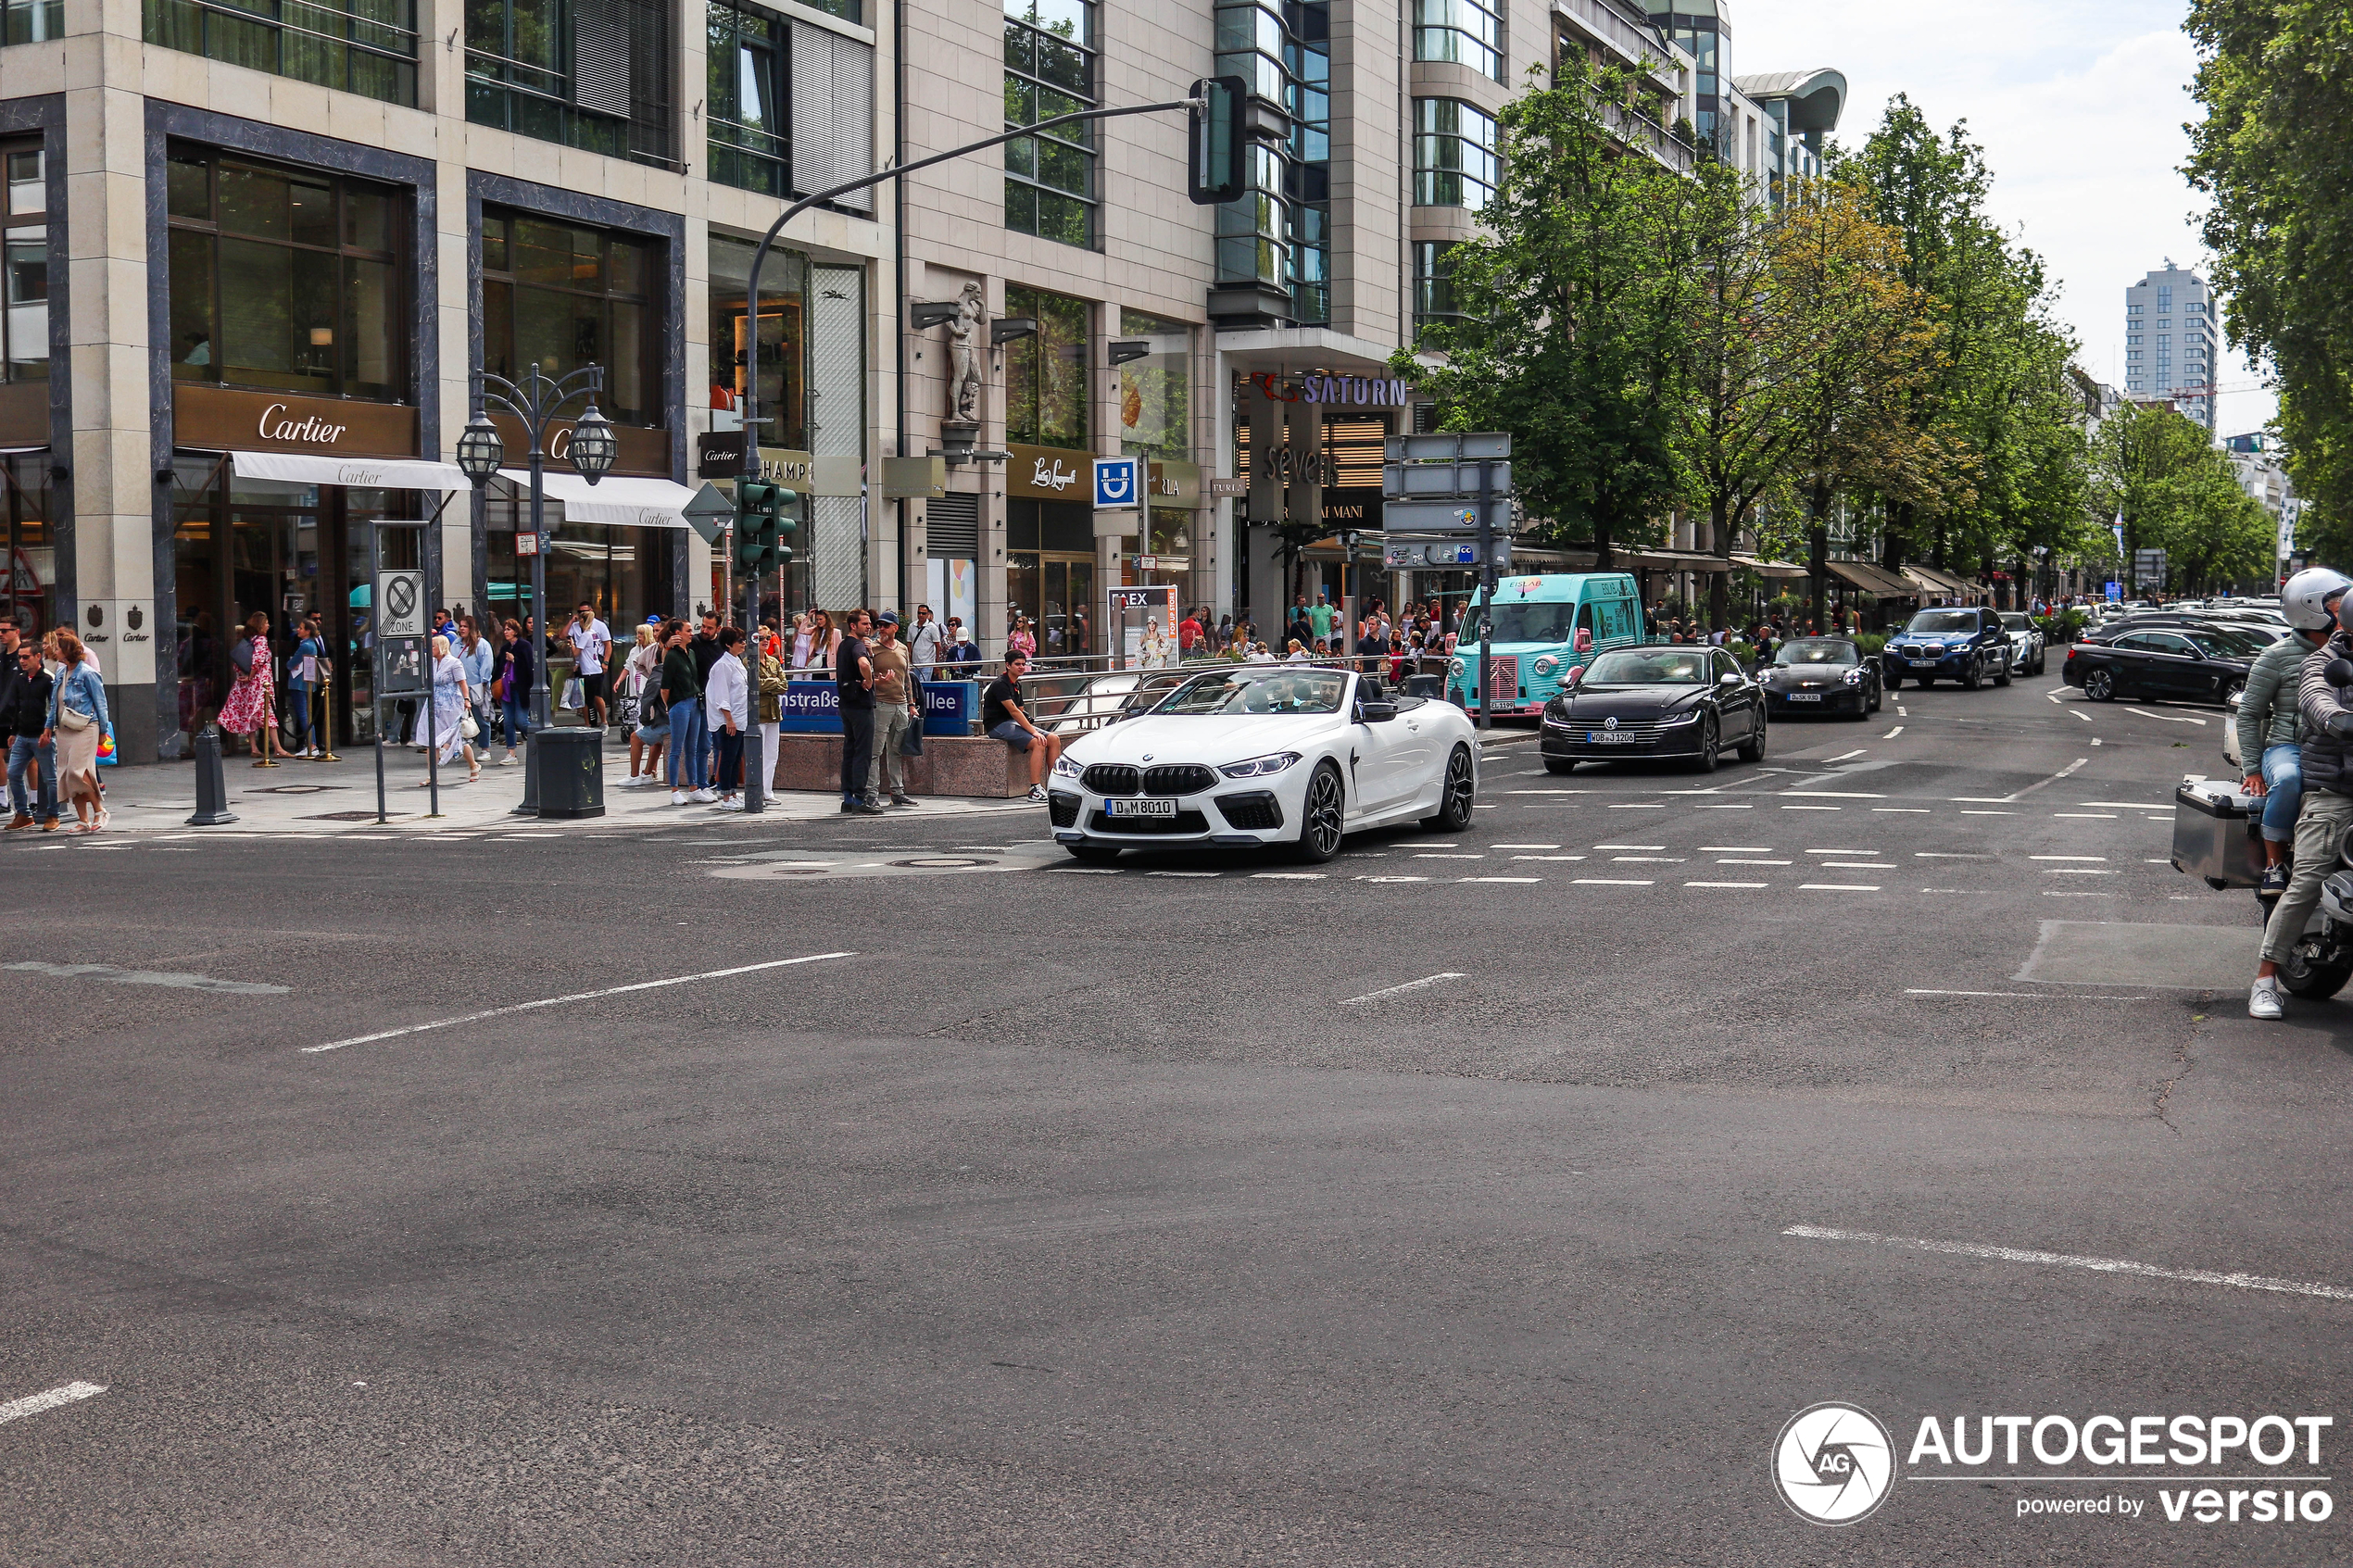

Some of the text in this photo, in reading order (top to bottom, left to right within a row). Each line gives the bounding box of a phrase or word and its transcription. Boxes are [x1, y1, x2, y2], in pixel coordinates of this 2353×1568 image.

[1304, 376, 1406, 406] SATURN
[259, 404, 346, 444] Cartier
[705, 450, 738, 461] Cartier
[1263, 445, 1340, 488] sevens
[338, 464, 382, 484] Cartier
[638, 508, 673, 526] Cartier
[1170, 611, 1176, 621] UP
[391, 621, 413, 633] ZONE
[84, 633, 109, 643] Cartier
[123, 633, 150, 643] Cartier
[779, 691, 840, 708] nstraße
[926, 692, 956, 709] llee
[1592, 734, 1605, 742] WOB
[1616, 733, 1634, 742] 1206
[1115, 801, 1124, 813] D
